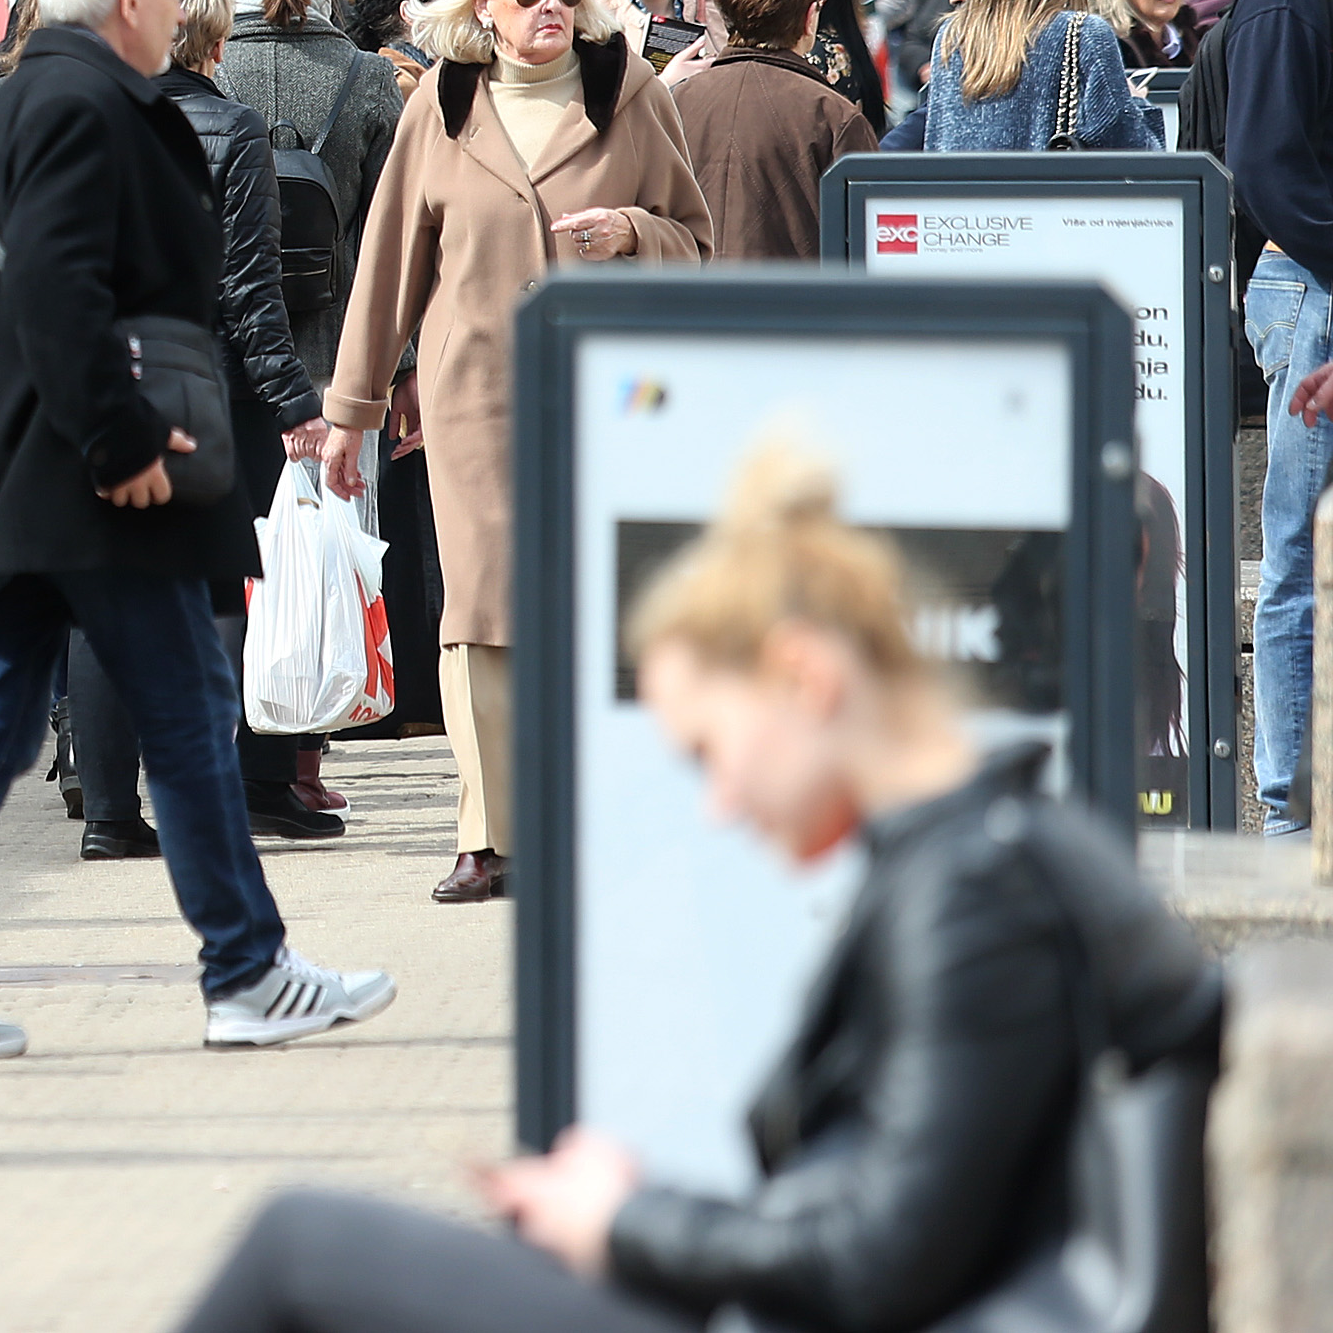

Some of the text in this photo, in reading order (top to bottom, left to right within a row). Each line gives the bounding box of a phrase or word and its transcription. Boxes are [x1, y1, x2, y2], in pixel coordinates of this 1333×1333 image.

[924, 216, 1033, 231] EXCLUSIVE
[876, 226, 918, 243] exc
[923, 232, 1011, 247] CHANGE
